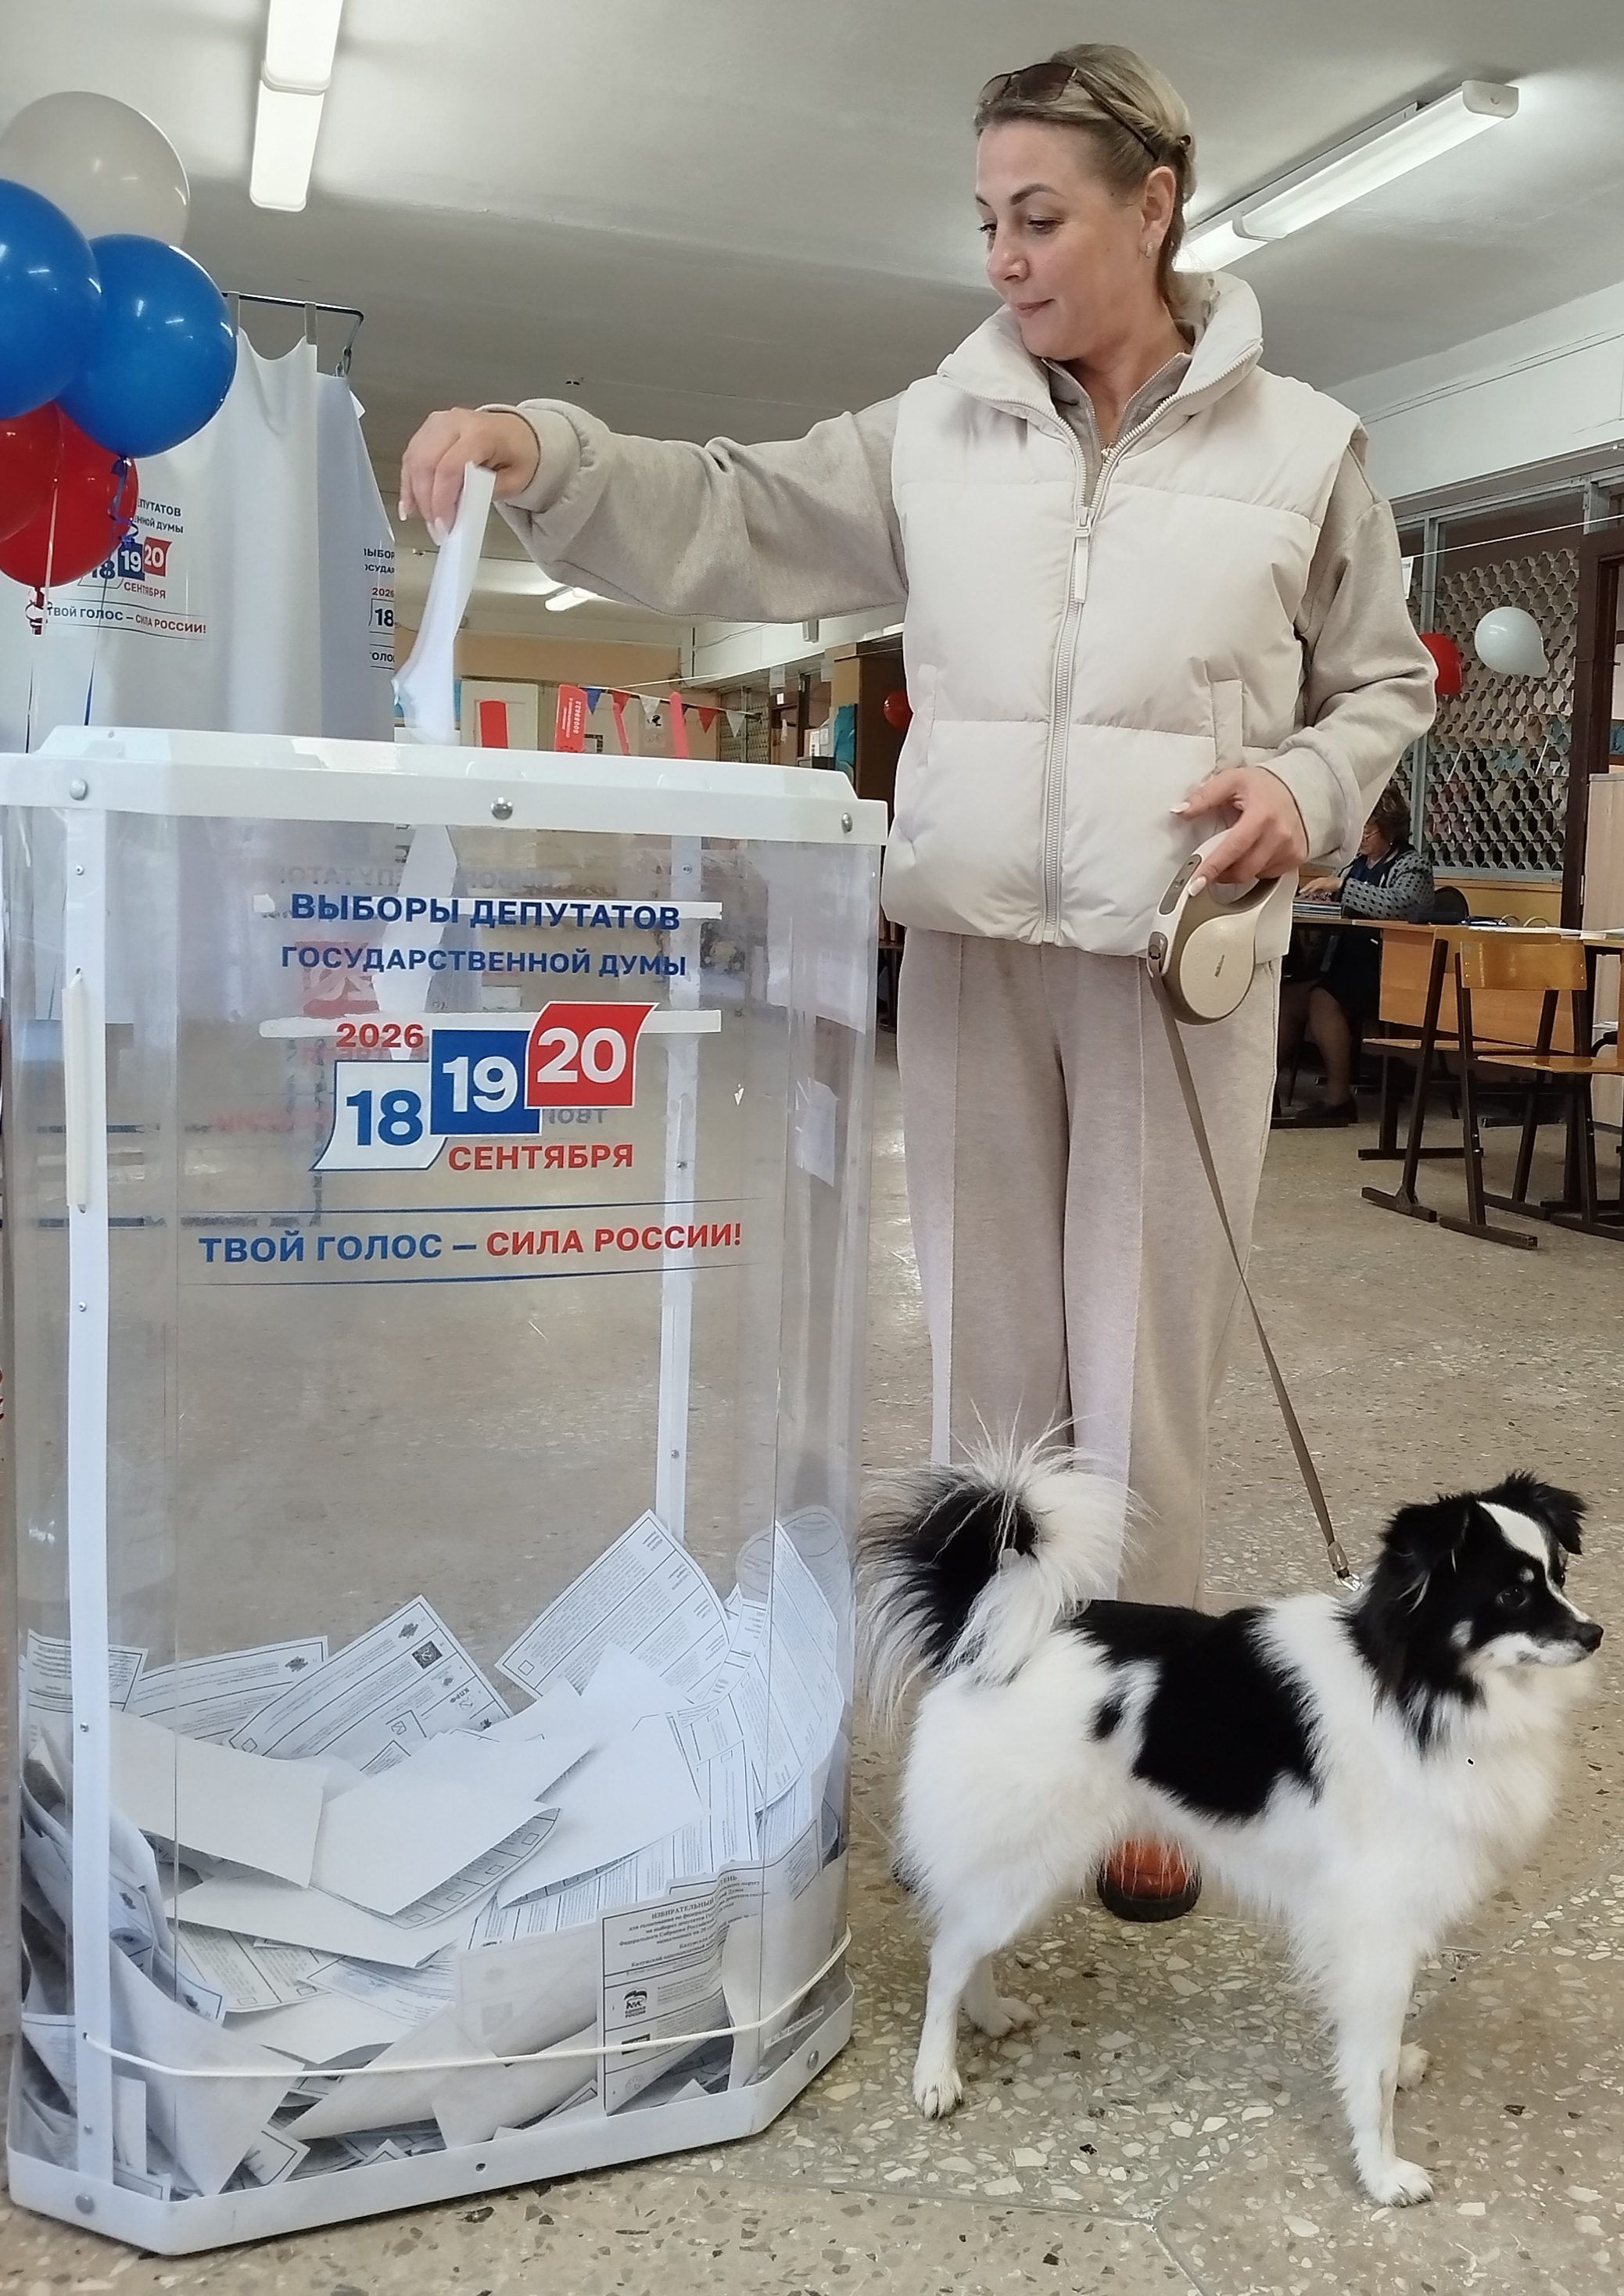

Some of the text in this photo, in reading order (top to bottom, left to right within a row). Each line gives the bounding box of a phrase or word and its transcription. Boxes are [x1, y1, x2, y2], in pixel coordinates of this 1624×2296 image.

[156, 522, 184, 533] ДУМЫ
[120, 550, 142, 572] 19
[144, 545, 164, 568] 20
[124, 582, 166, 599] СЕНТЯБРЯ
[48, 605, 77, 617] ТВОЙ
[80, 608, 123, 621] ГОЛОС
[135, 614, 152, 626] СИЛА
[154, 619, 206, 633] РОССИИ!
[375, 608, 394, 627] 18
[370, 651, 395, 662] ОЛО
[291, 893, 680, 930] ВЫБОРЫ ДЕПУТАТОВ
[281, 945, 687, 978] ГОСУДАРСТВЕННОЙ ДУМЫ
[336, 1023, 424, 1048] 2026
[346, 1089, 423, 1146] 18
[442, 1056, 518, 1113] 19
[536, 1028, 628, 1083] 20
[448, 1144, 633, 1171] СЕНТЯБРЯ
[199, 1229, 304, 1263] ТВОЙ
[317, 1234, 443, 1261] ГОЛОС
[487, 1229, 584, 1256] СИЛА
[594, 1223, 742, 1252] РОССИИ!
[450, 1688, 469, 1703] КПРФ
[651, 1897, 715, 1919] ИЗБИРАТЕЛЬНЫЙ
